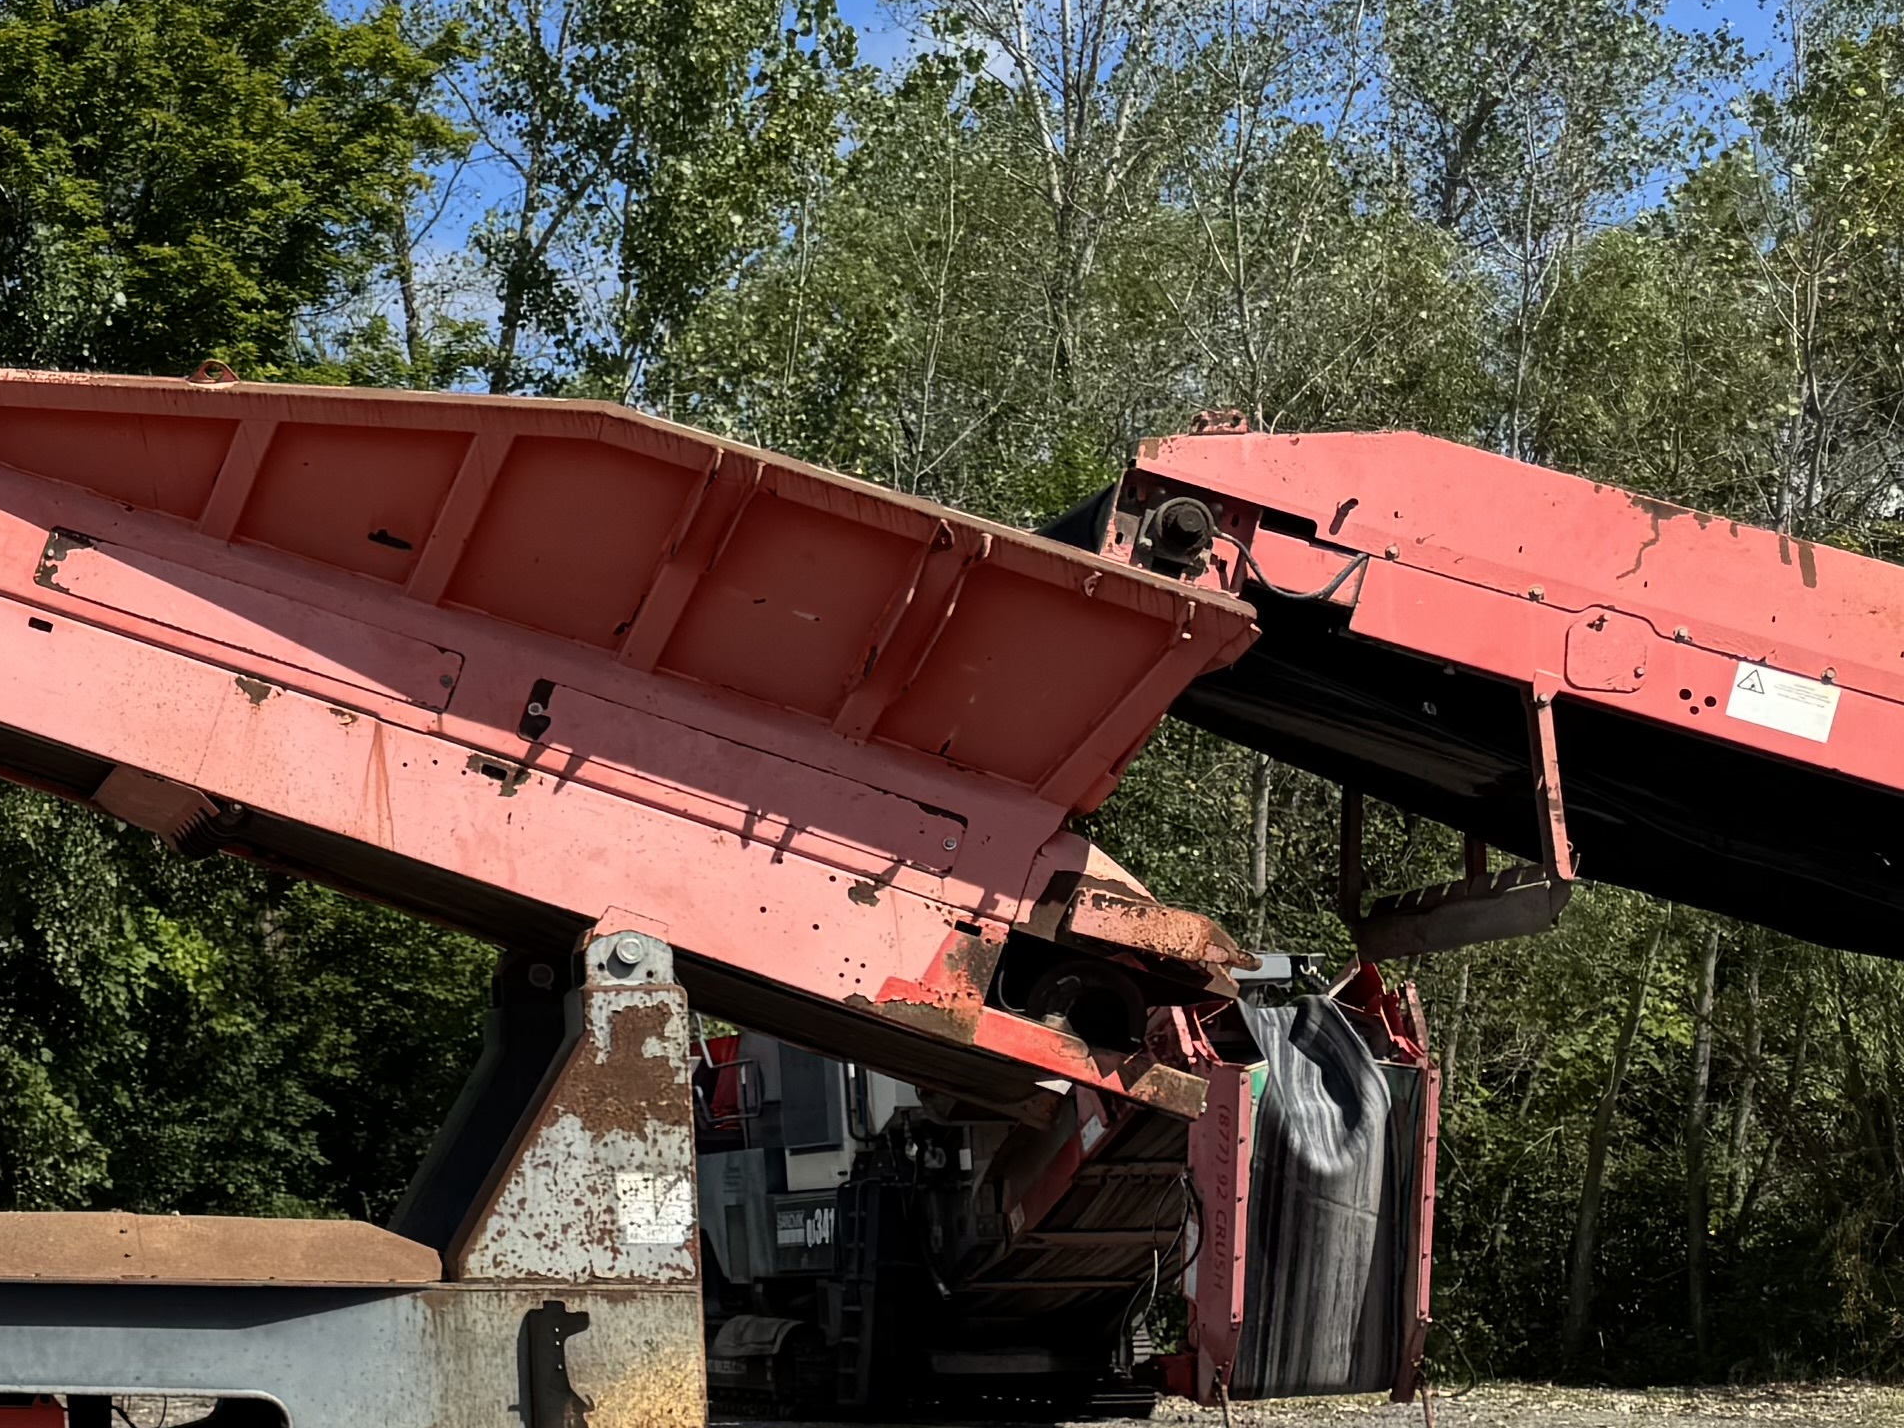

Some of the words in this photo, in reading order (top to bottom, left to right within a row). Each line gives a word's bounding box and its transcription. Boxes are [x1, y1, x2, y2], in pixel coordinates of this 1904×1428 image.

[1216, 1104, 1231, 1164] (877)
[1216, 1173, 1229, 1201] 92
[1214, 1210, 1227, 1290] CRUSH
